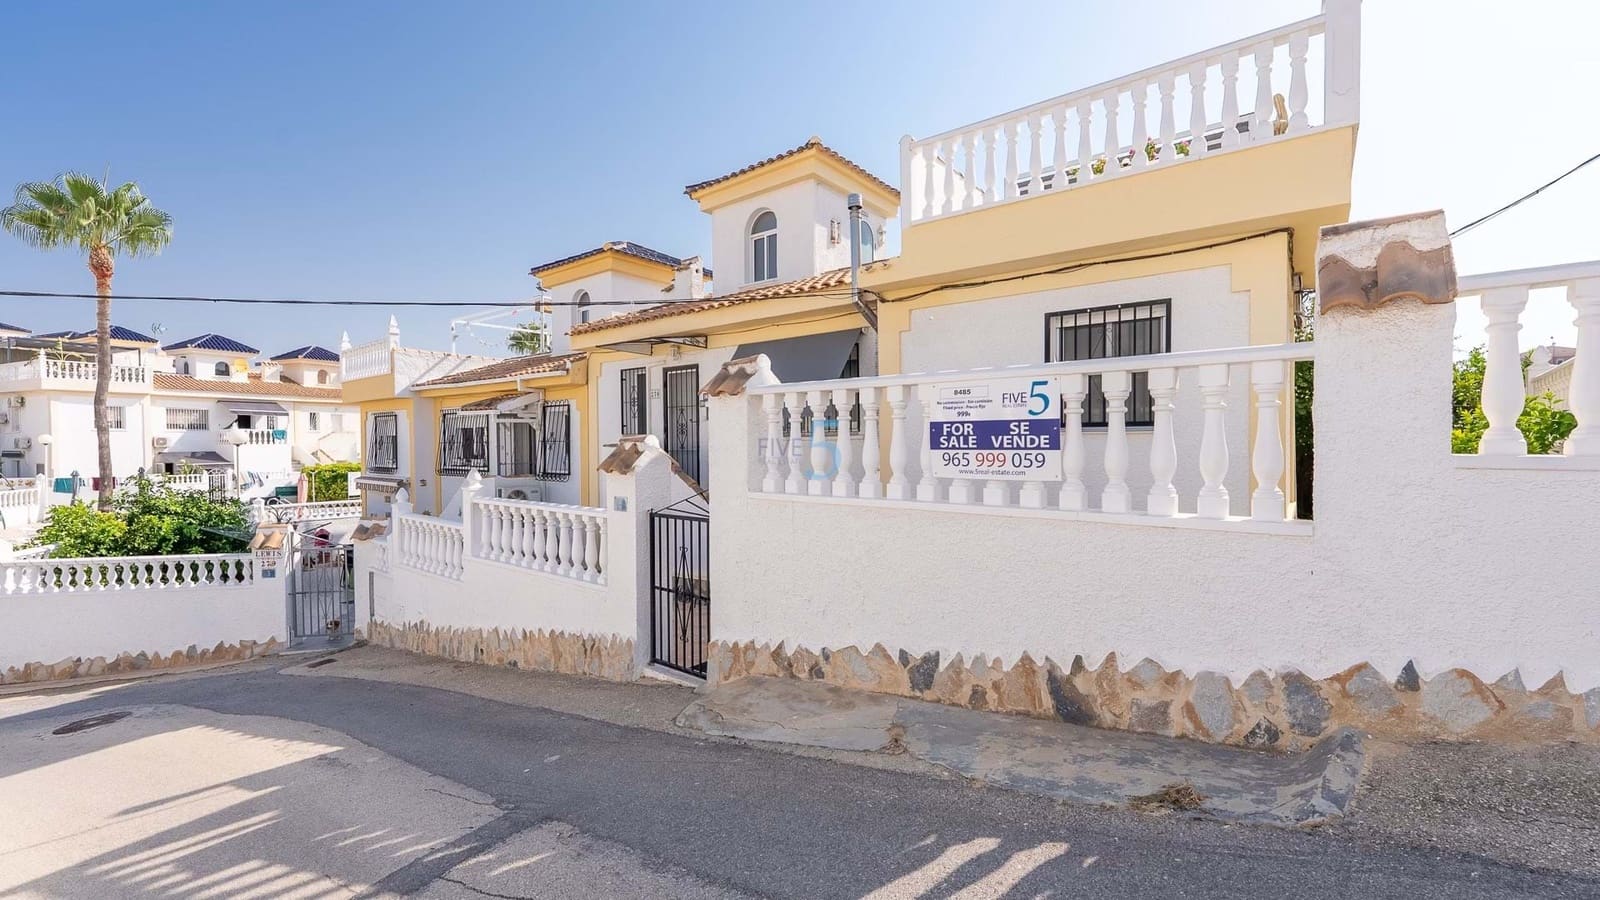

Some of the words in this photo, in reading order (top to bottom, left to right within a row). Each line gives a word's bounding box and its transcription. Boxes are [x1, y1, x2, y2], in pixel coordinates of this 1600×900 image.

[1002, 391, 1027, 404] FIVE
[1028, 380, 1050, 416] 5
[943, 423, 974, 436] FOR
[1009, 422, 1030, 435] SE
[939, 436, 978, 449] SALE
[991, 435, 1050, 448] VENDE
[942, 452, 970, 467] 965
[975, 452, 1007, 468] 999
[1011, 452, 1046, 469] 059
[959, 468, 1026, 476] www.5real-estate.com
